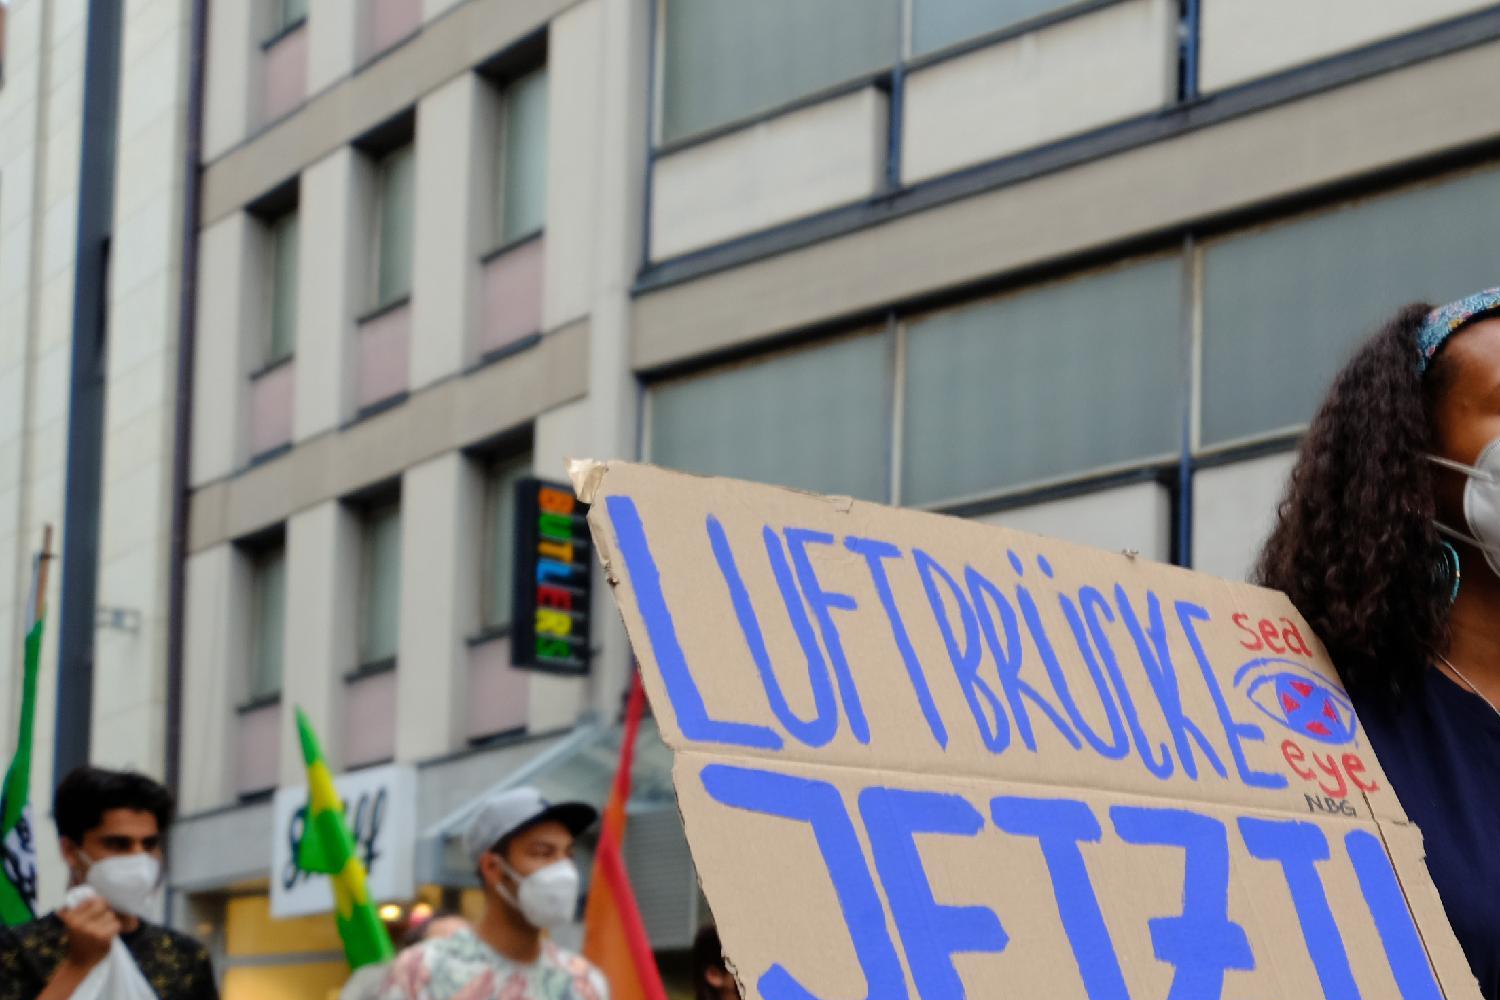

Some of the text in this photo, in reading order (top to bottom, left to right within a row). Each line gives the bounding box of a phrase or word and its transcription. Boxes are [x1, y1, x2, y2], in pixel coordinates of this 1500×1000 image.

[535, 485, 576, 658] BUTLERS
[605, 494, 1288, 790] LUFTBRÜCKE
[1231, 613, 1313, 658] sea
[1280, 739, 1380, 799] eye
[1304, 793, 1358, 818] NBG
